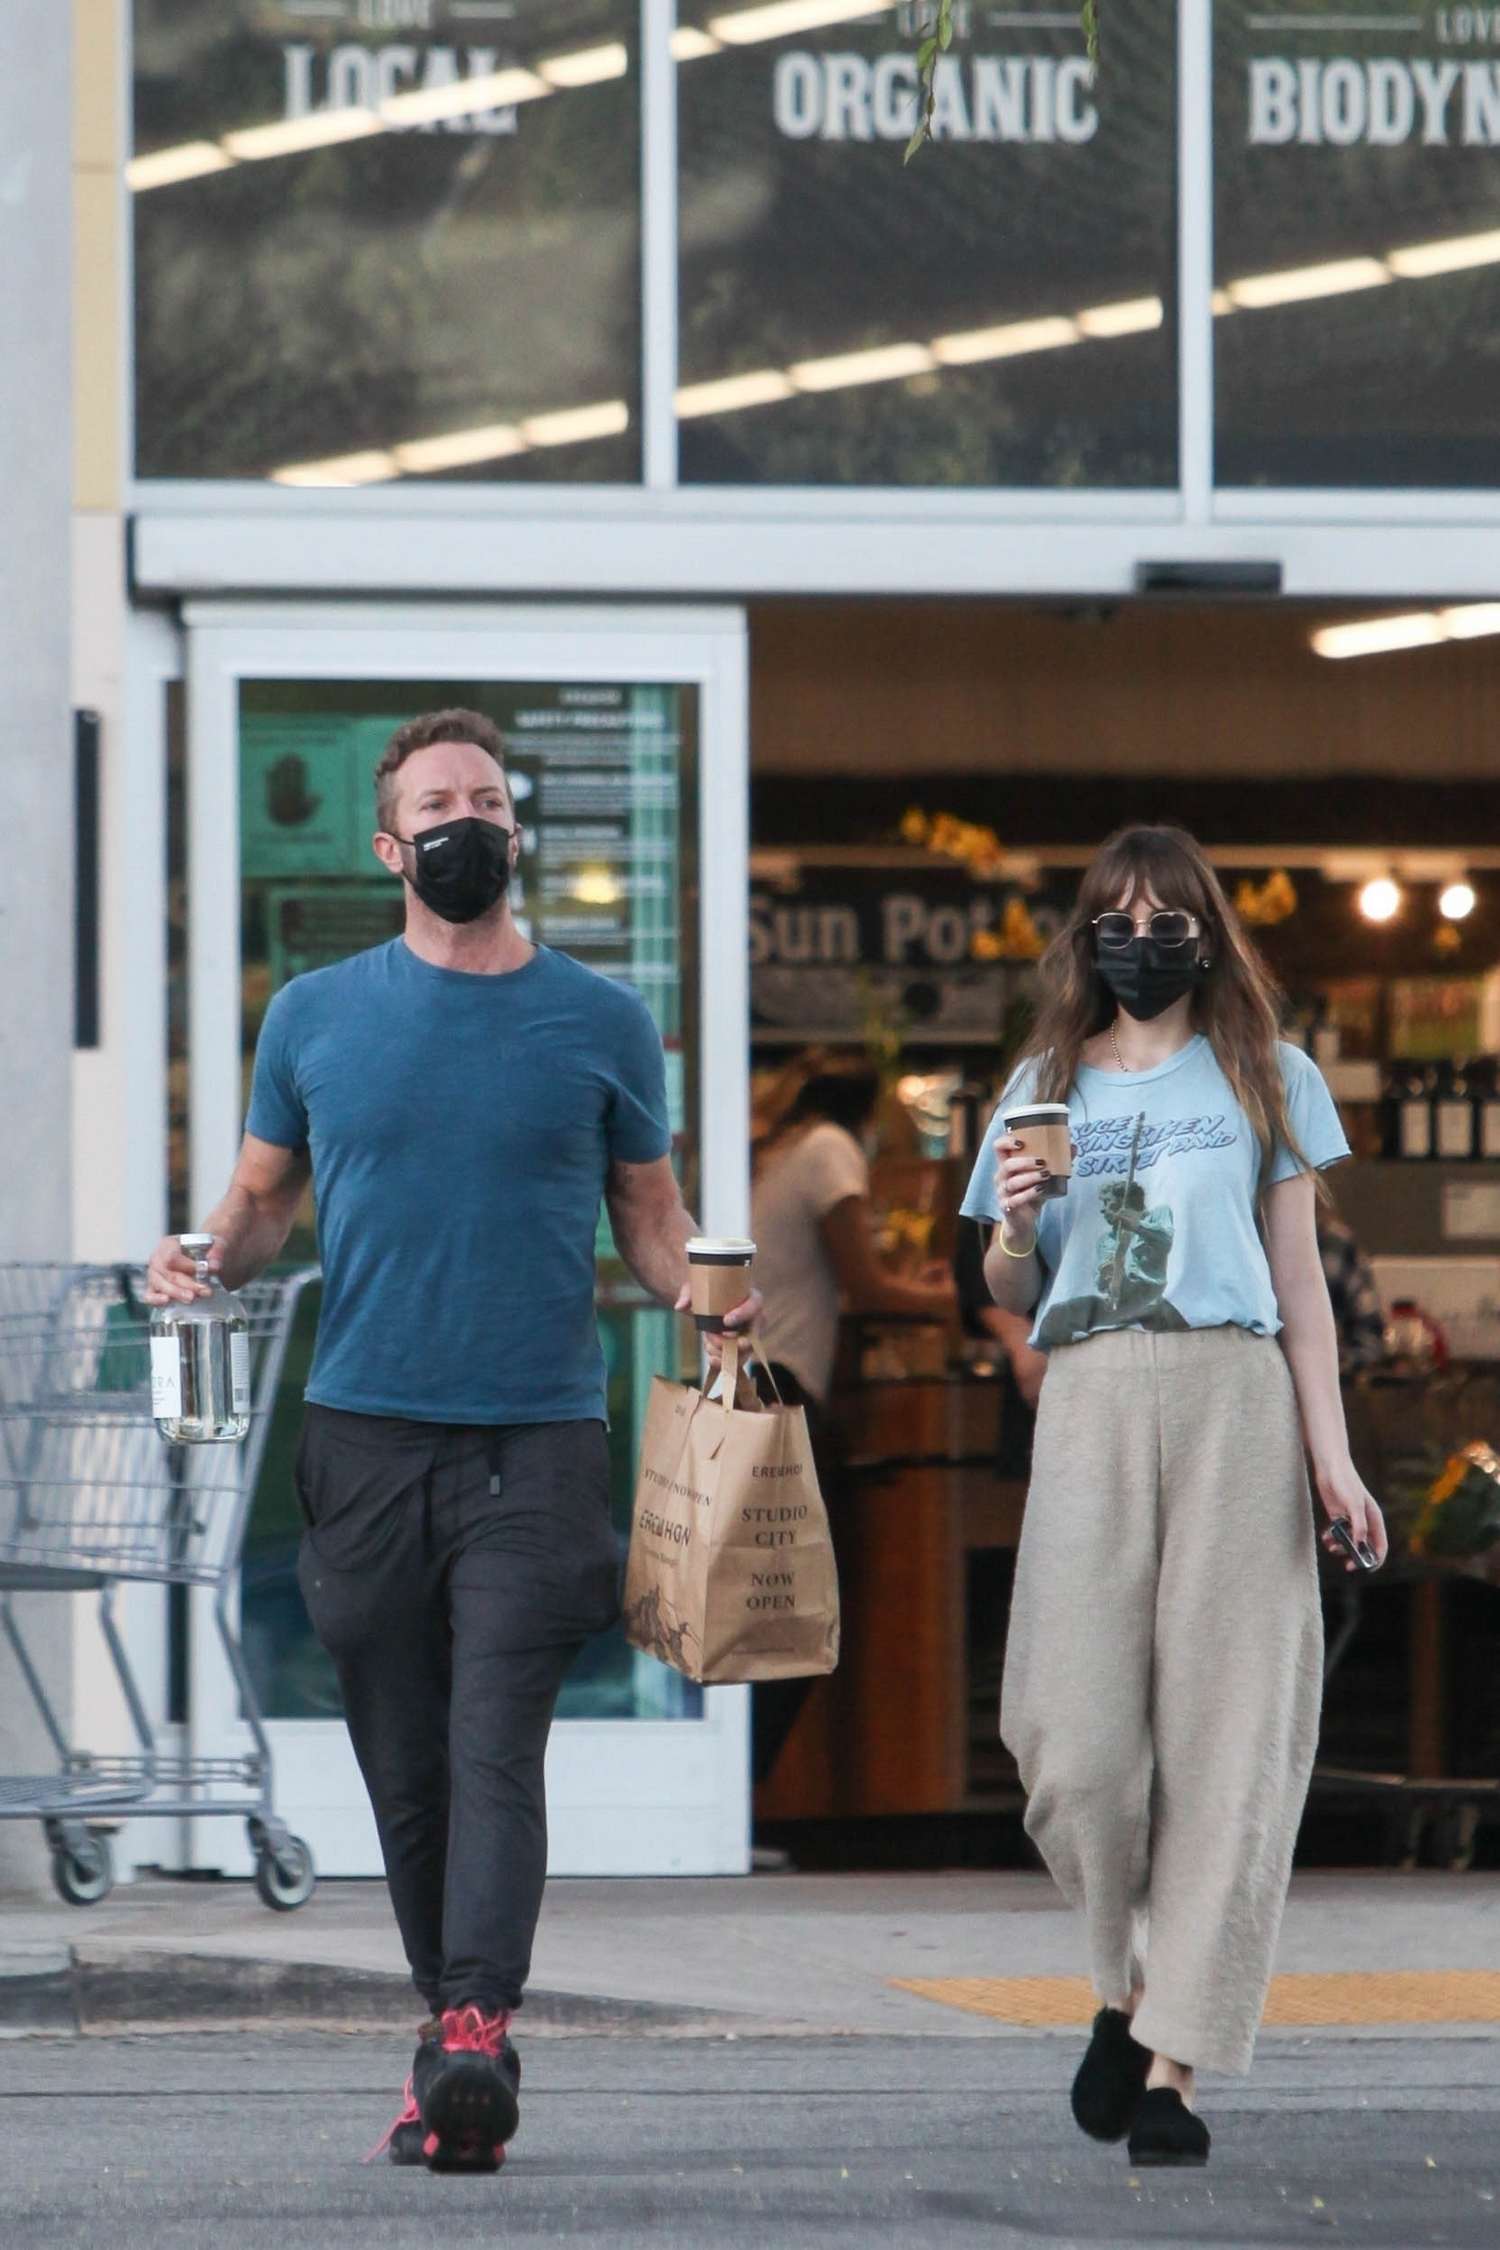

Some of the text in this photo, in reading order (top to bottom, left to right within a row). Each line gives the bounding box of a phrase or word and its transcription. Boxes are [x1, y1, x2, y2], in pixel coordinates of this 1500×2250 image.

[773, 52, 1099, 143] ORGANIC
[1249, 57, 1500, 145] BIODYN
[750, 893, 859, 961] Sun
[1077, 1141, 1171, 1178] STRET
[742, 1505, 808, 1523] STUDIO
[755, 1529, 797, 1546] CITY
[751, 1571, 795, 1588] NOW
[746, 1593, 796, 1610] OPEN
